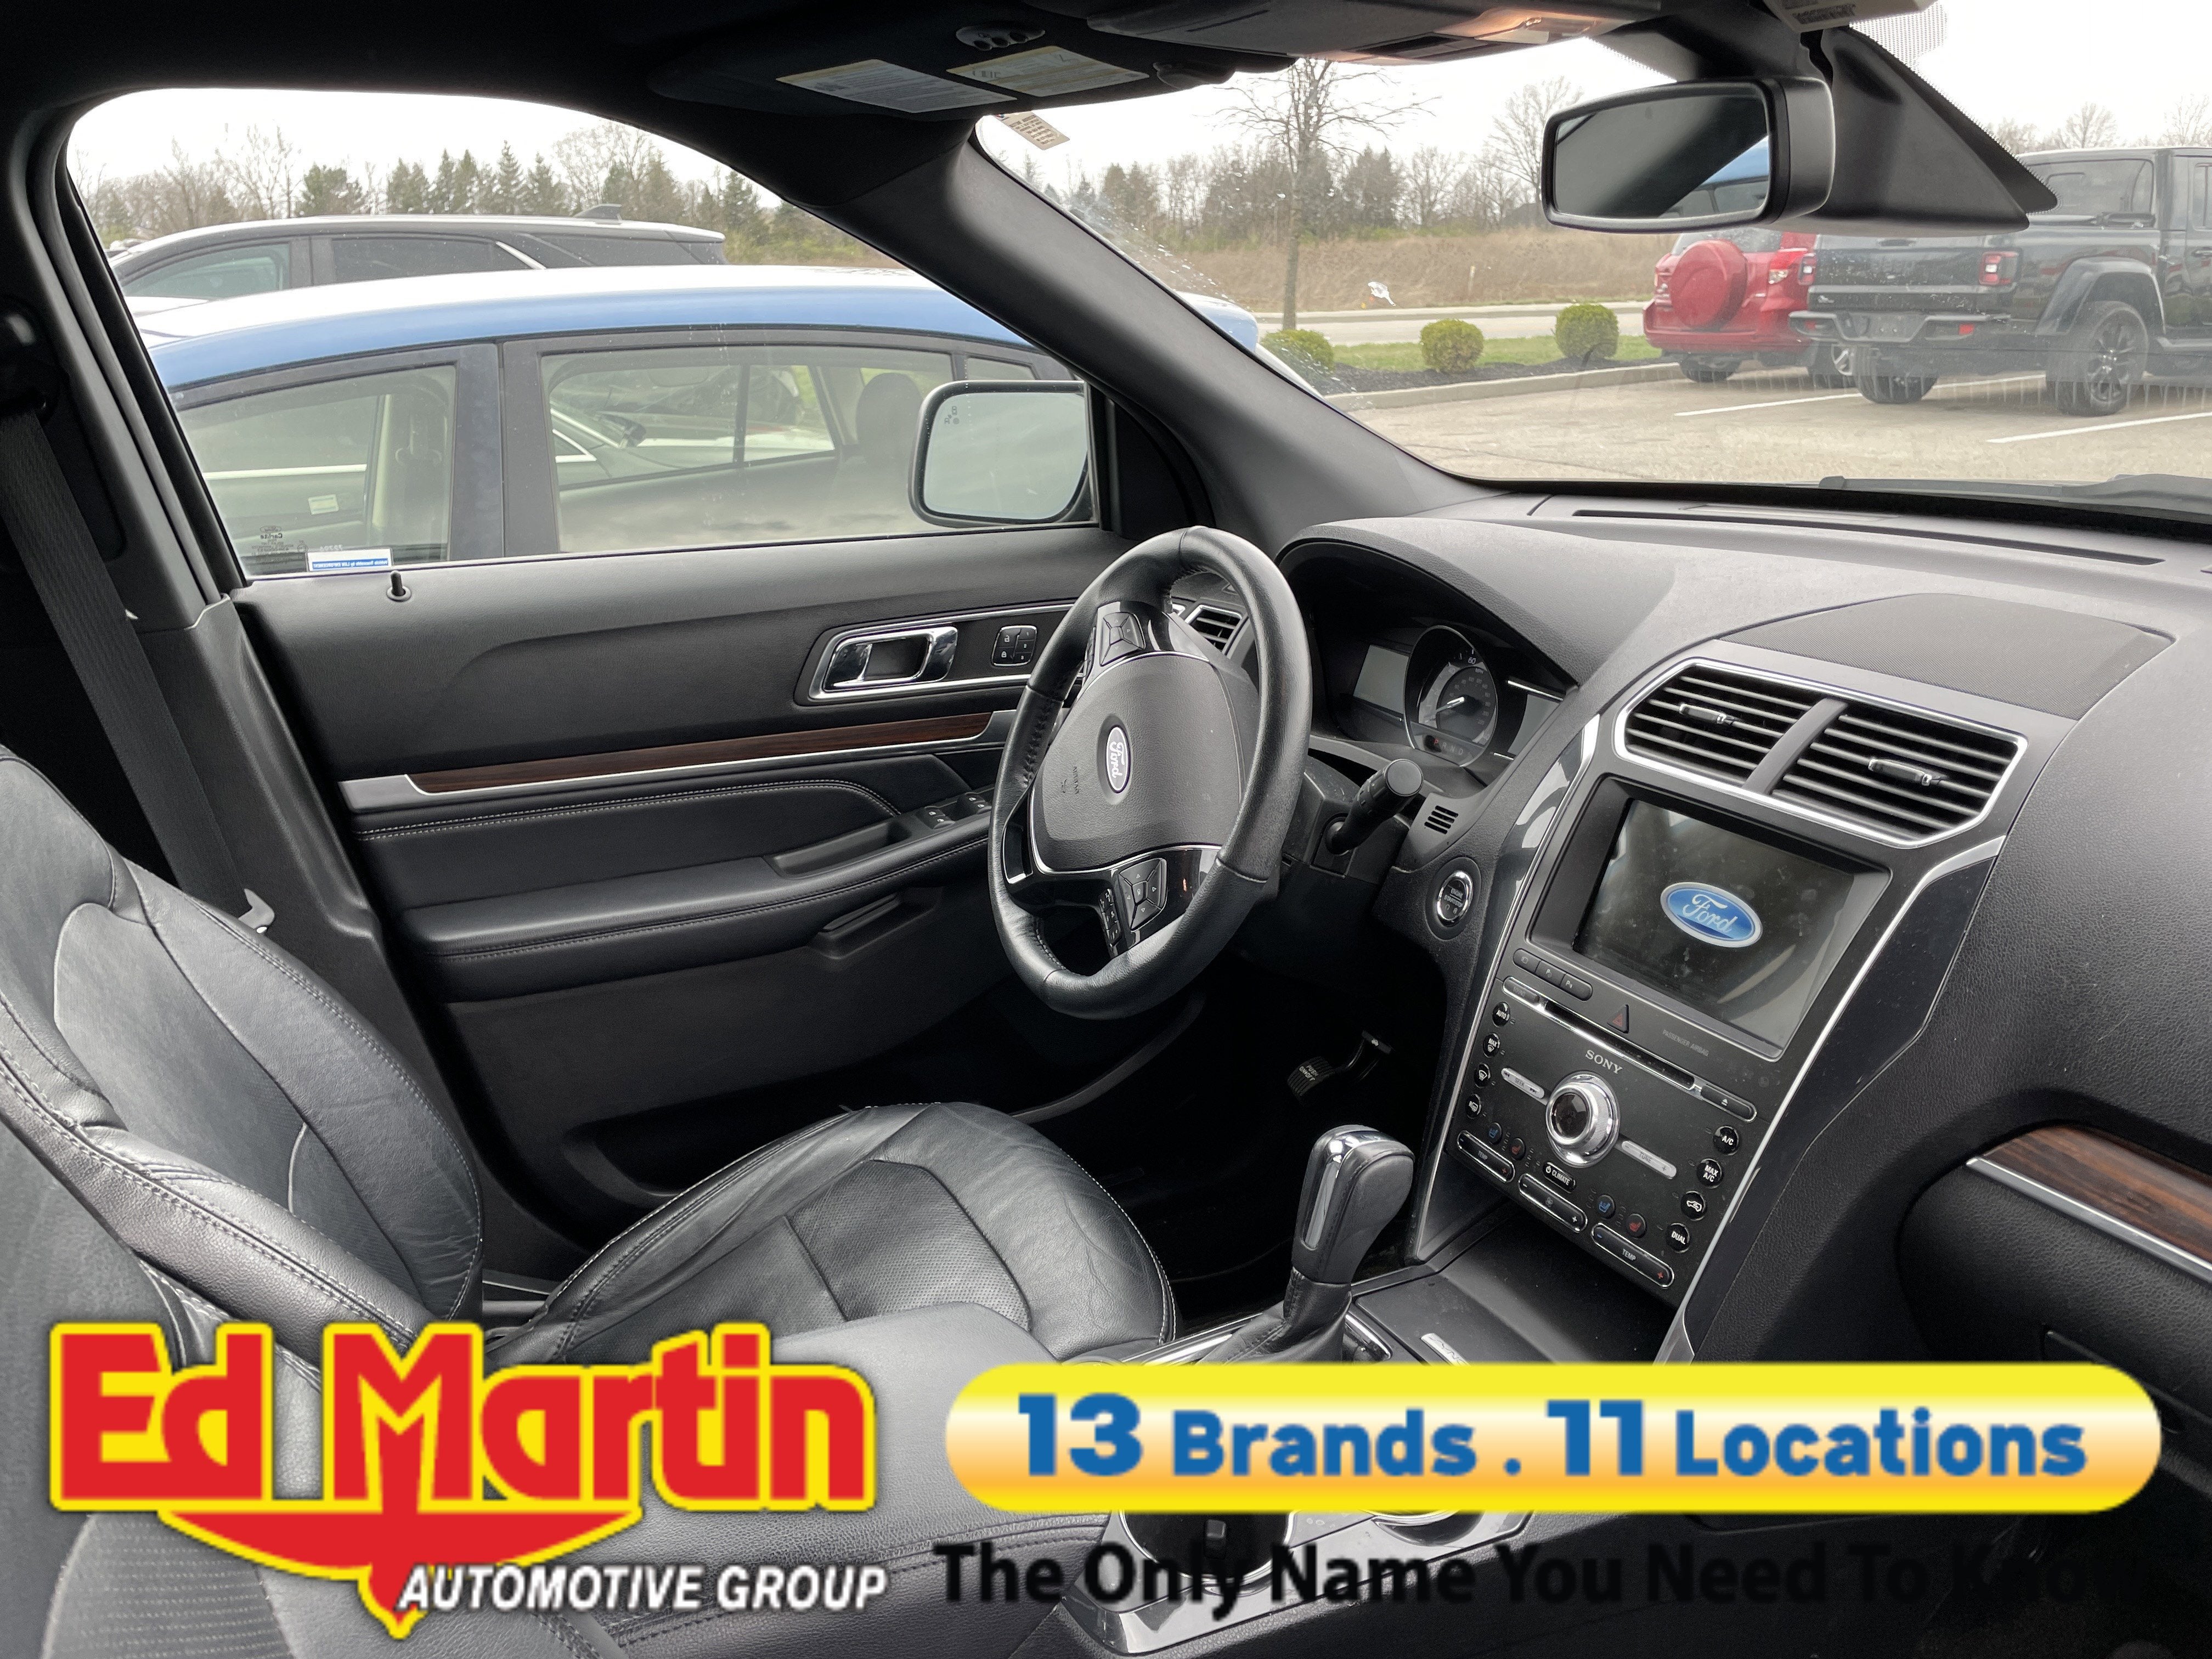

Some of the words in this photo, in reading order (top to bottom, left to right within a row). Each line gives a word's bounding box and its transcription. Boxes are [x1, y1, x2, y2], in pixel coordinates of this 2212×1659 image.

[1109, 741, 1125, 778] Ford
[1682, 894, 1738, 933] Ford
[1496, 1010, 1506, 1019] AUTO
[1488, 1038, 1498, 1047] MAX
[1662, 1029, 1690, 1047] PASSENGER
[1585, 1049, 1623, 1075] SONY
[1722, 1136, 1734, 1146] A/C
[1639, 1152, 1652, 1164] TUNE
[1703, 1172, 1715, 1182] A/C
[1705, 1165, 1719, 1177] MAX
[1551, 1169, 1570, 1186] CLIMATE
[1671, 1231, 1686, 1245] DUAL
[1622, 1249, 1636, 1261] TEMP
